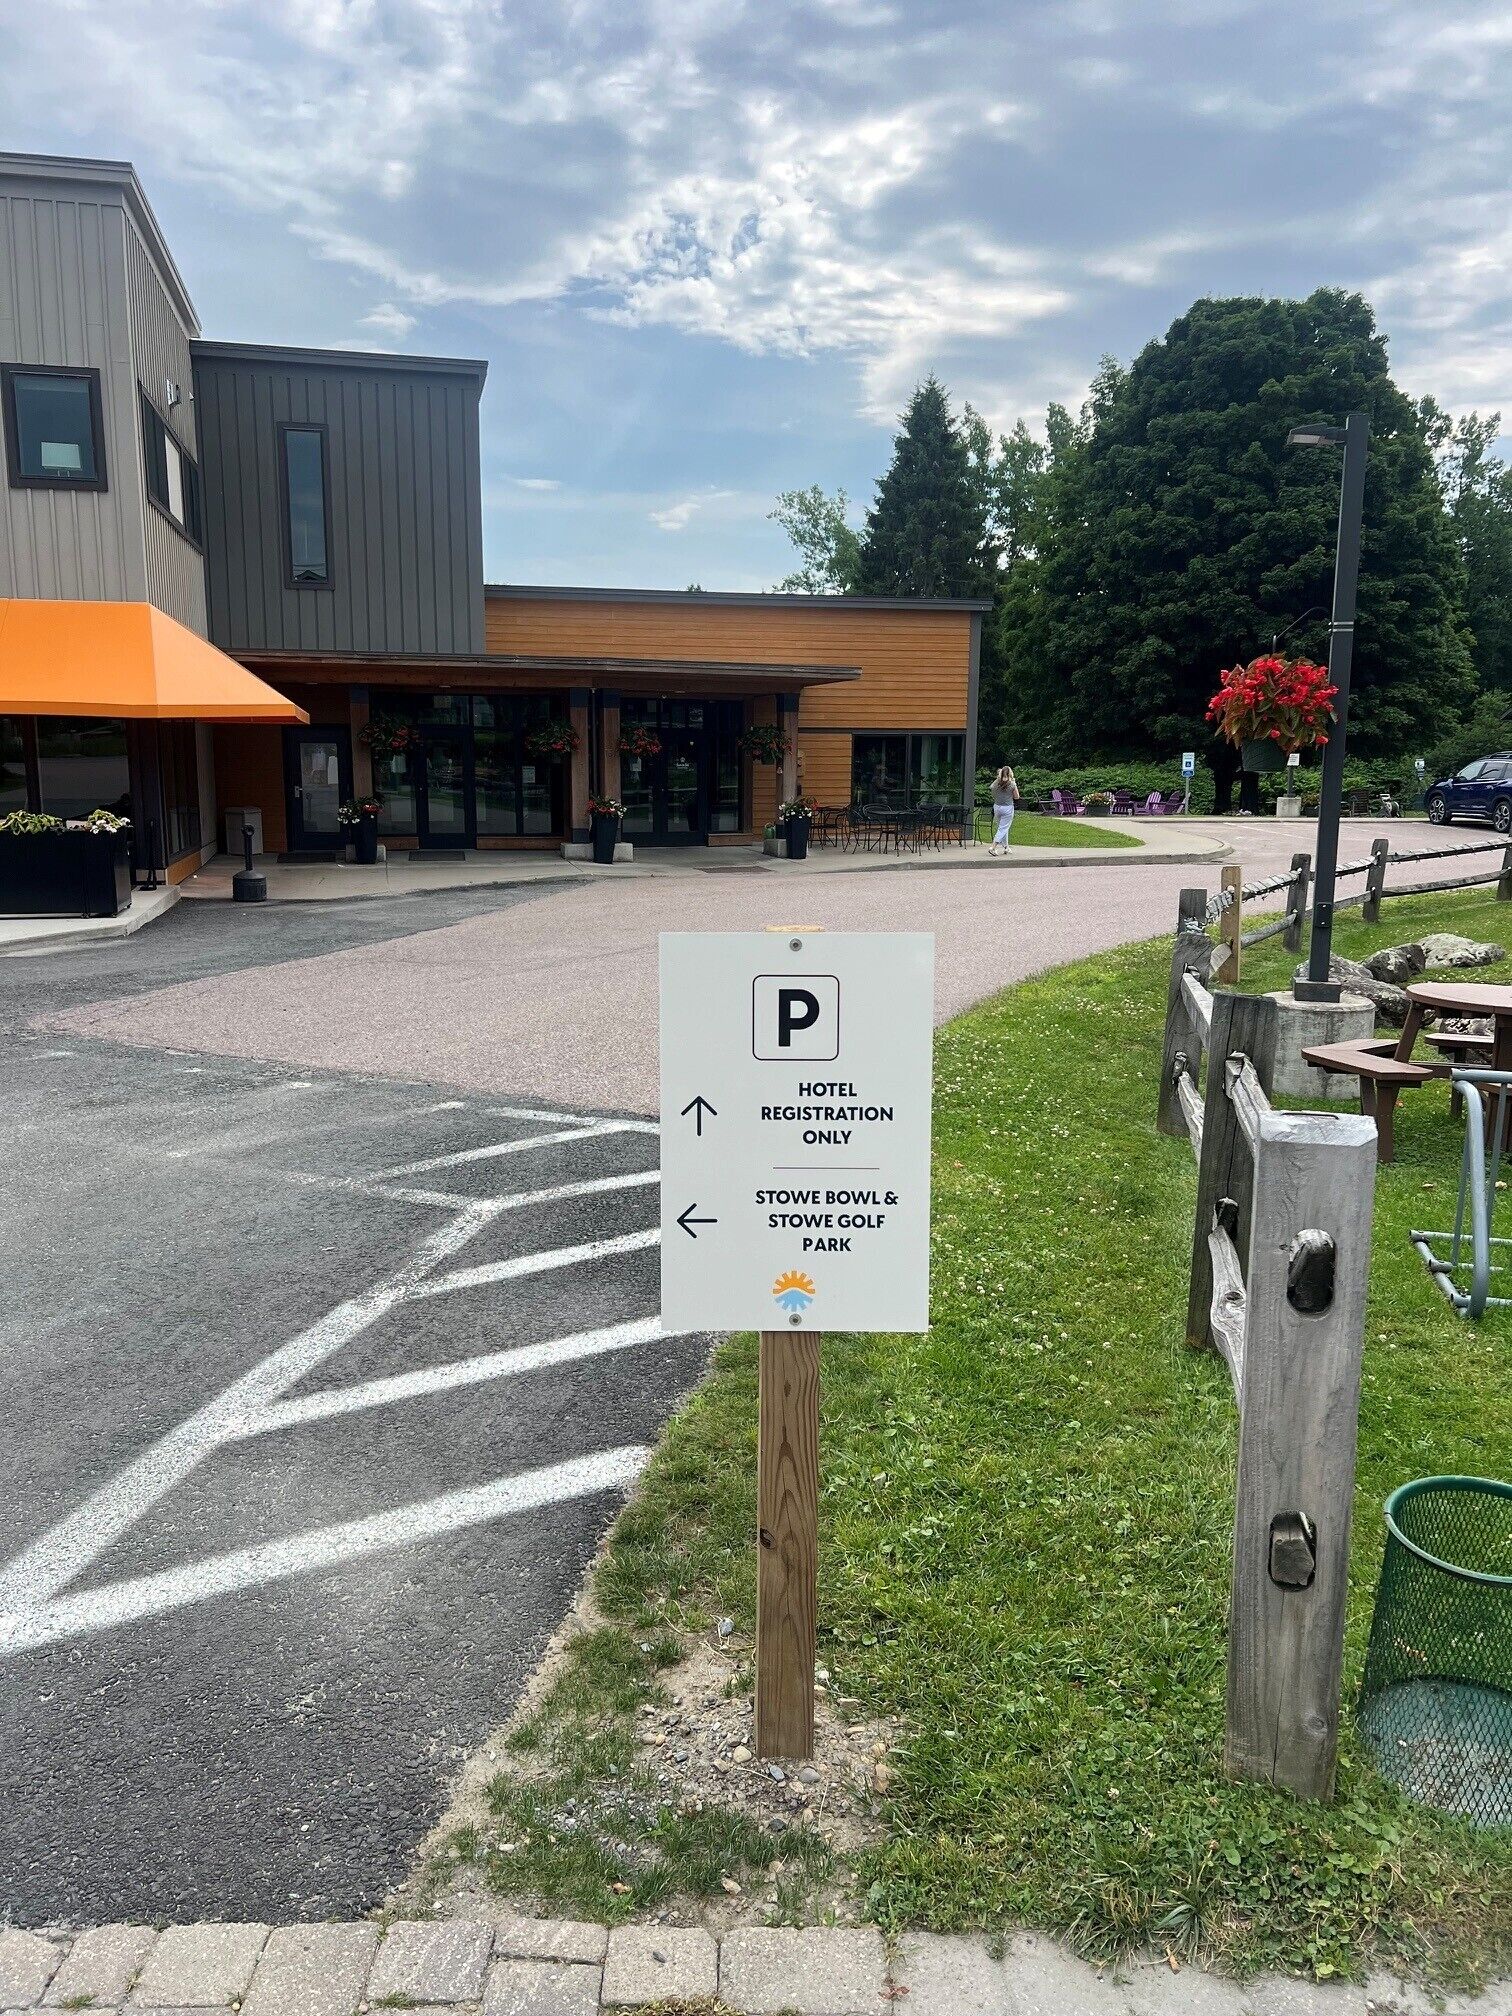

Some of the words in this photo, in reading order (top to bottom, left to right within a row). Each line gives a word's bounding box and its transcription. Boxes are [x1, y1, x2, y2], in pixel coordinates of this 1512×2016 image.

[778, 988, 820, 1048] P
[798, 1082, 858, 1098] HOTEL
[761, 1105, 894, 1122] REGISTRATION
[802, 1129, 853, 1145] ONLY
[755, 1189, 821, 1205] STOWE
[825, 1190, 881, 1206] BOWL
[883, 1190, 899, 1206] &
[768, 1213, 834, 1229] STOWE
[837, 1213, 886, 1229] GOLF
[802, 1237, 852, 1252] PARK
